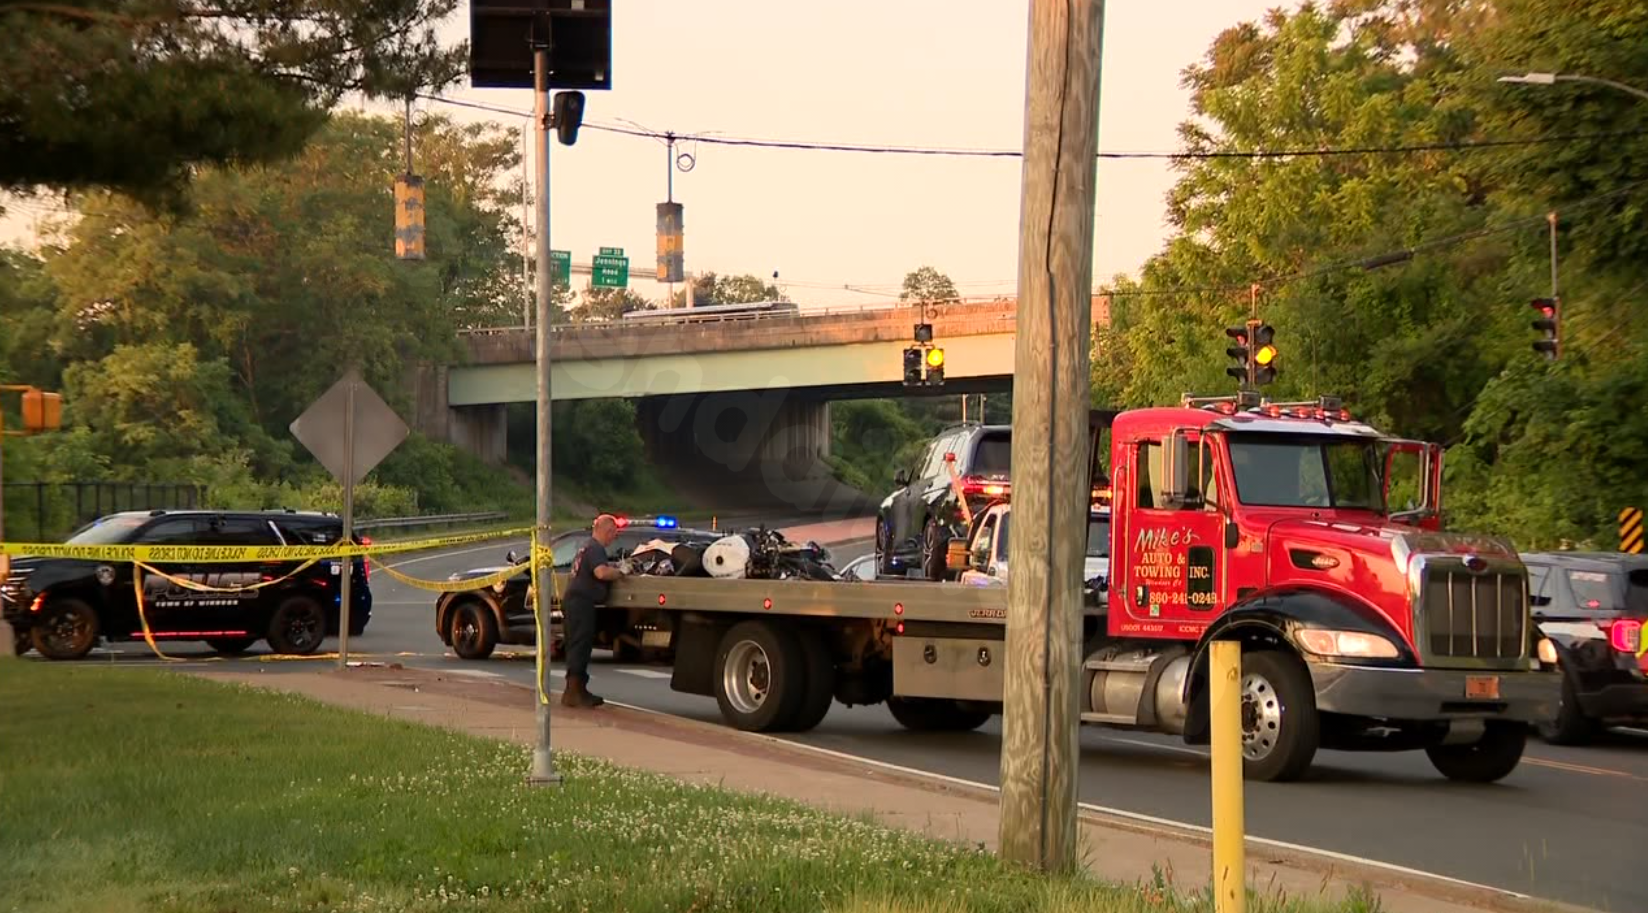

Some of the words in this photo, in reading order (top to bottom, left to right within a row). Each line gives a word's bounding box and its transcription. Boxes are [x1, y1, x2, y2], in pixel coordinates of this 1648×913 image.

[1134, 526, 1200, 553] Mike's
[1141, 552, 1173, 565] AUTO
[1177, 553, 1186, 564] &
[1134, 565, 1181, 578] TOWING
[1189, 566, 1210, 579] INC.
